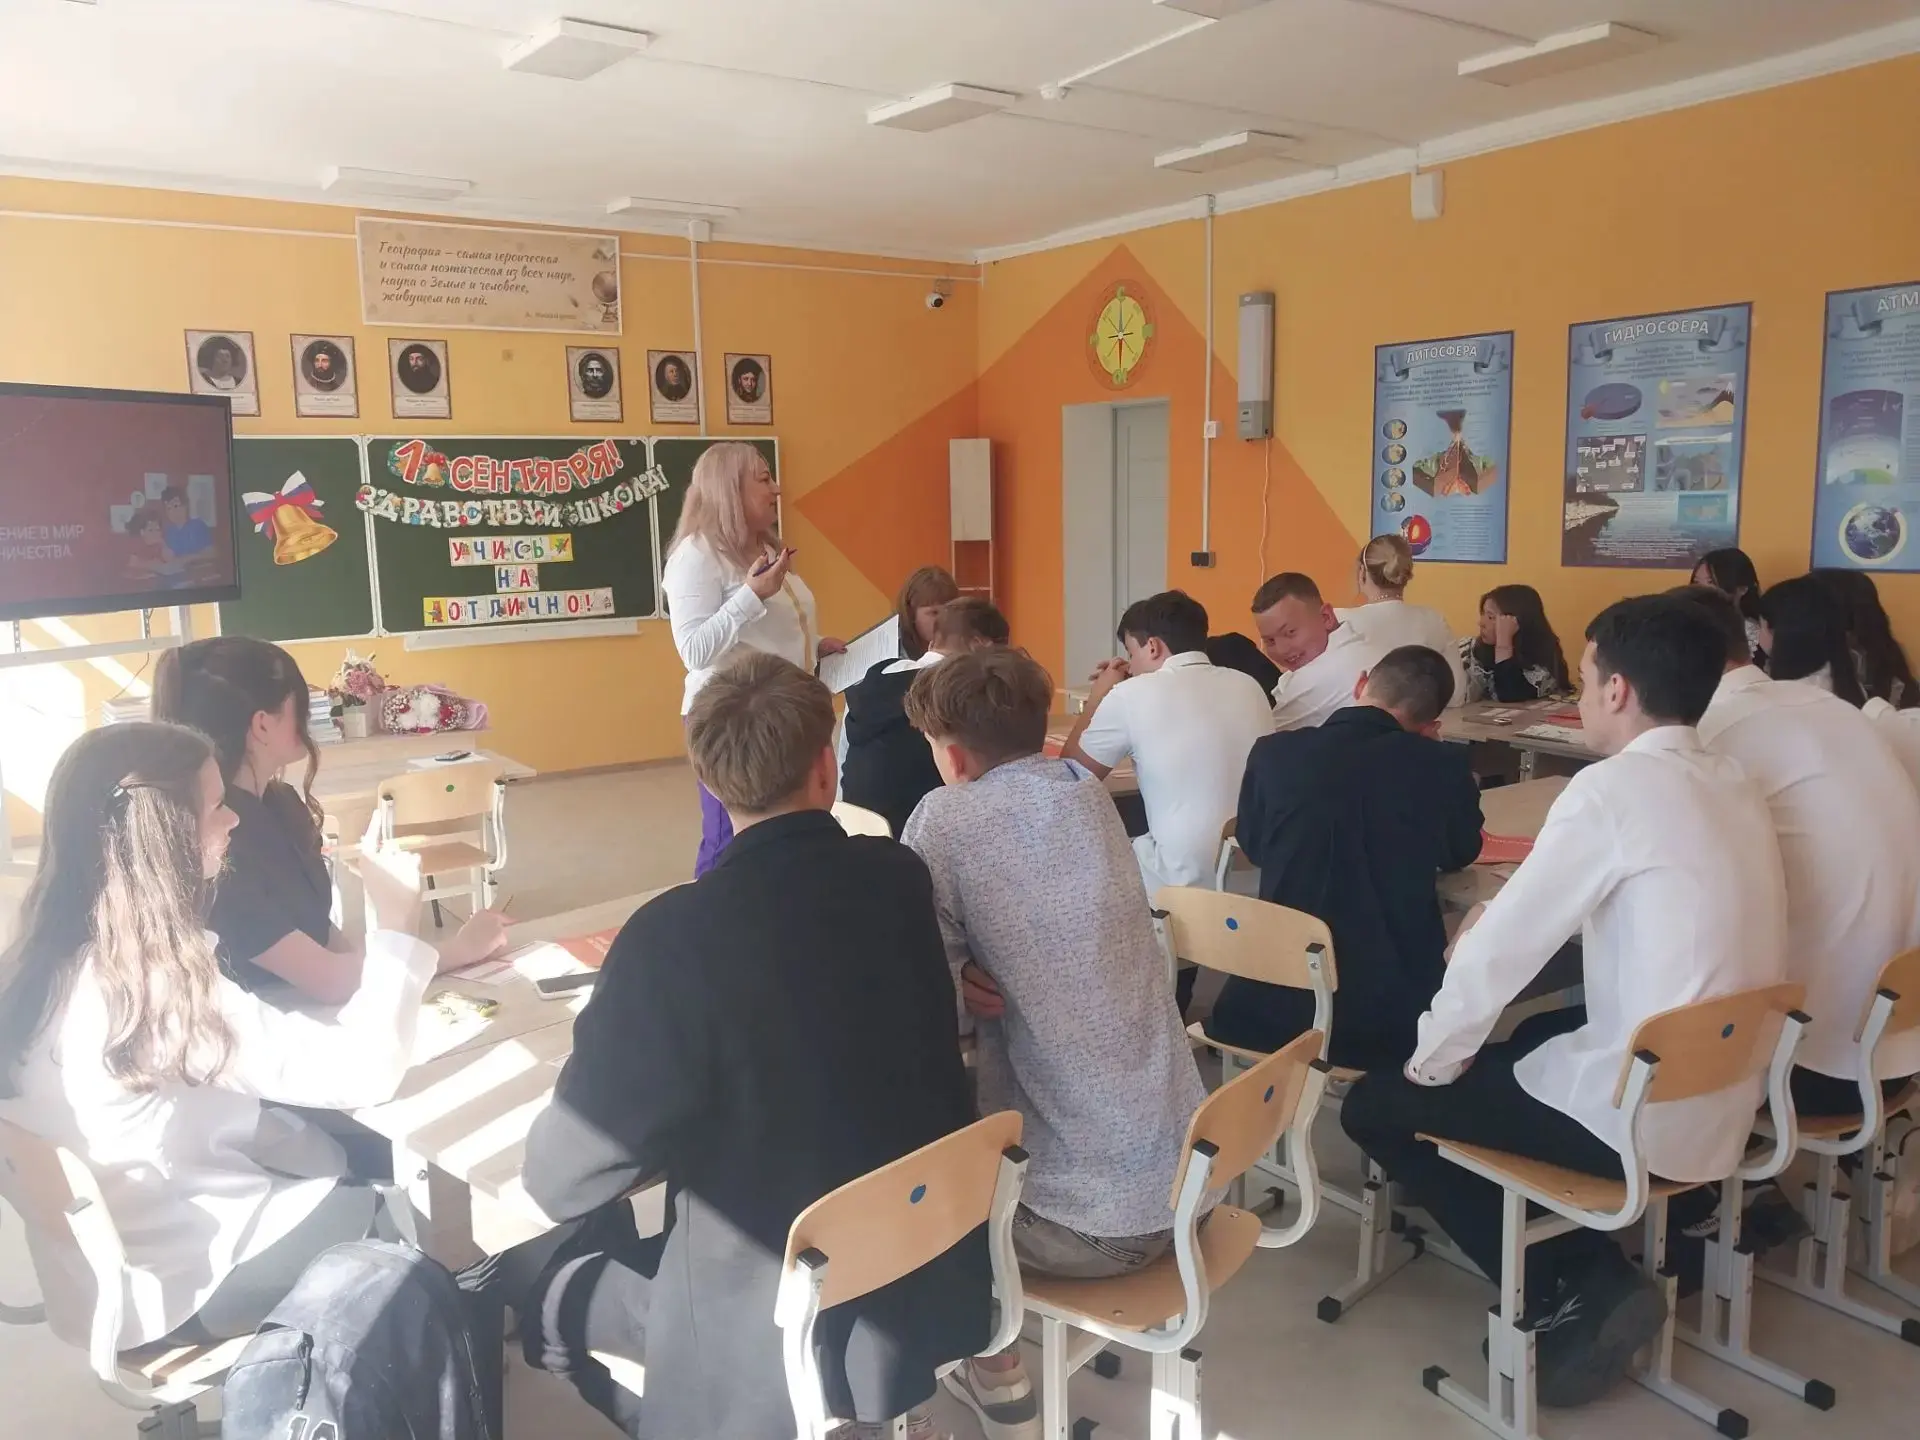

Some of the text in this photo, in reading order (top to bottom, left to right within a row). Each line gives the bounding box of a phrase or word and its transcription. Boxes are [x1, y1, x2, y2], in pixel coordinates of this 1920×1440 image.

[379, 241, 442, 260] География
[456, 250, 491, 260] самая
[494, 252, 559, 265] героическая
[379, 261, 387, 269] и
[390, 262, 428, 271] самая
[430, 263, 503, 276] поэтическая
[506, 268, 517, 281] из
[521, 264, 543, 278] всех
[380, 276, 416, 291] наука
[420, 279, 427, 287] о
[429, 276, 466, 288] Земле
[468, 281, 476, 290] и
[382, 289, 443, 307] живущем
[445, 295, 461, 304] на
[1604, 319, 1709, 344] ГИДРОСФЕРА
[1406, 345, 1478, 364] ЛИТОСФЕРА
[394, 438, 624, 493] 1 СЕНТЯБРЯ!
[575, 463, 670, 525] ШКОЛА!
[52, 524, 85, 540] МИР
[452, 539, 545, 561] УЧИСЬ
[498, 567, 531, 588] НА
[448, 593, 592, 621] ОТЛИЧНО!
